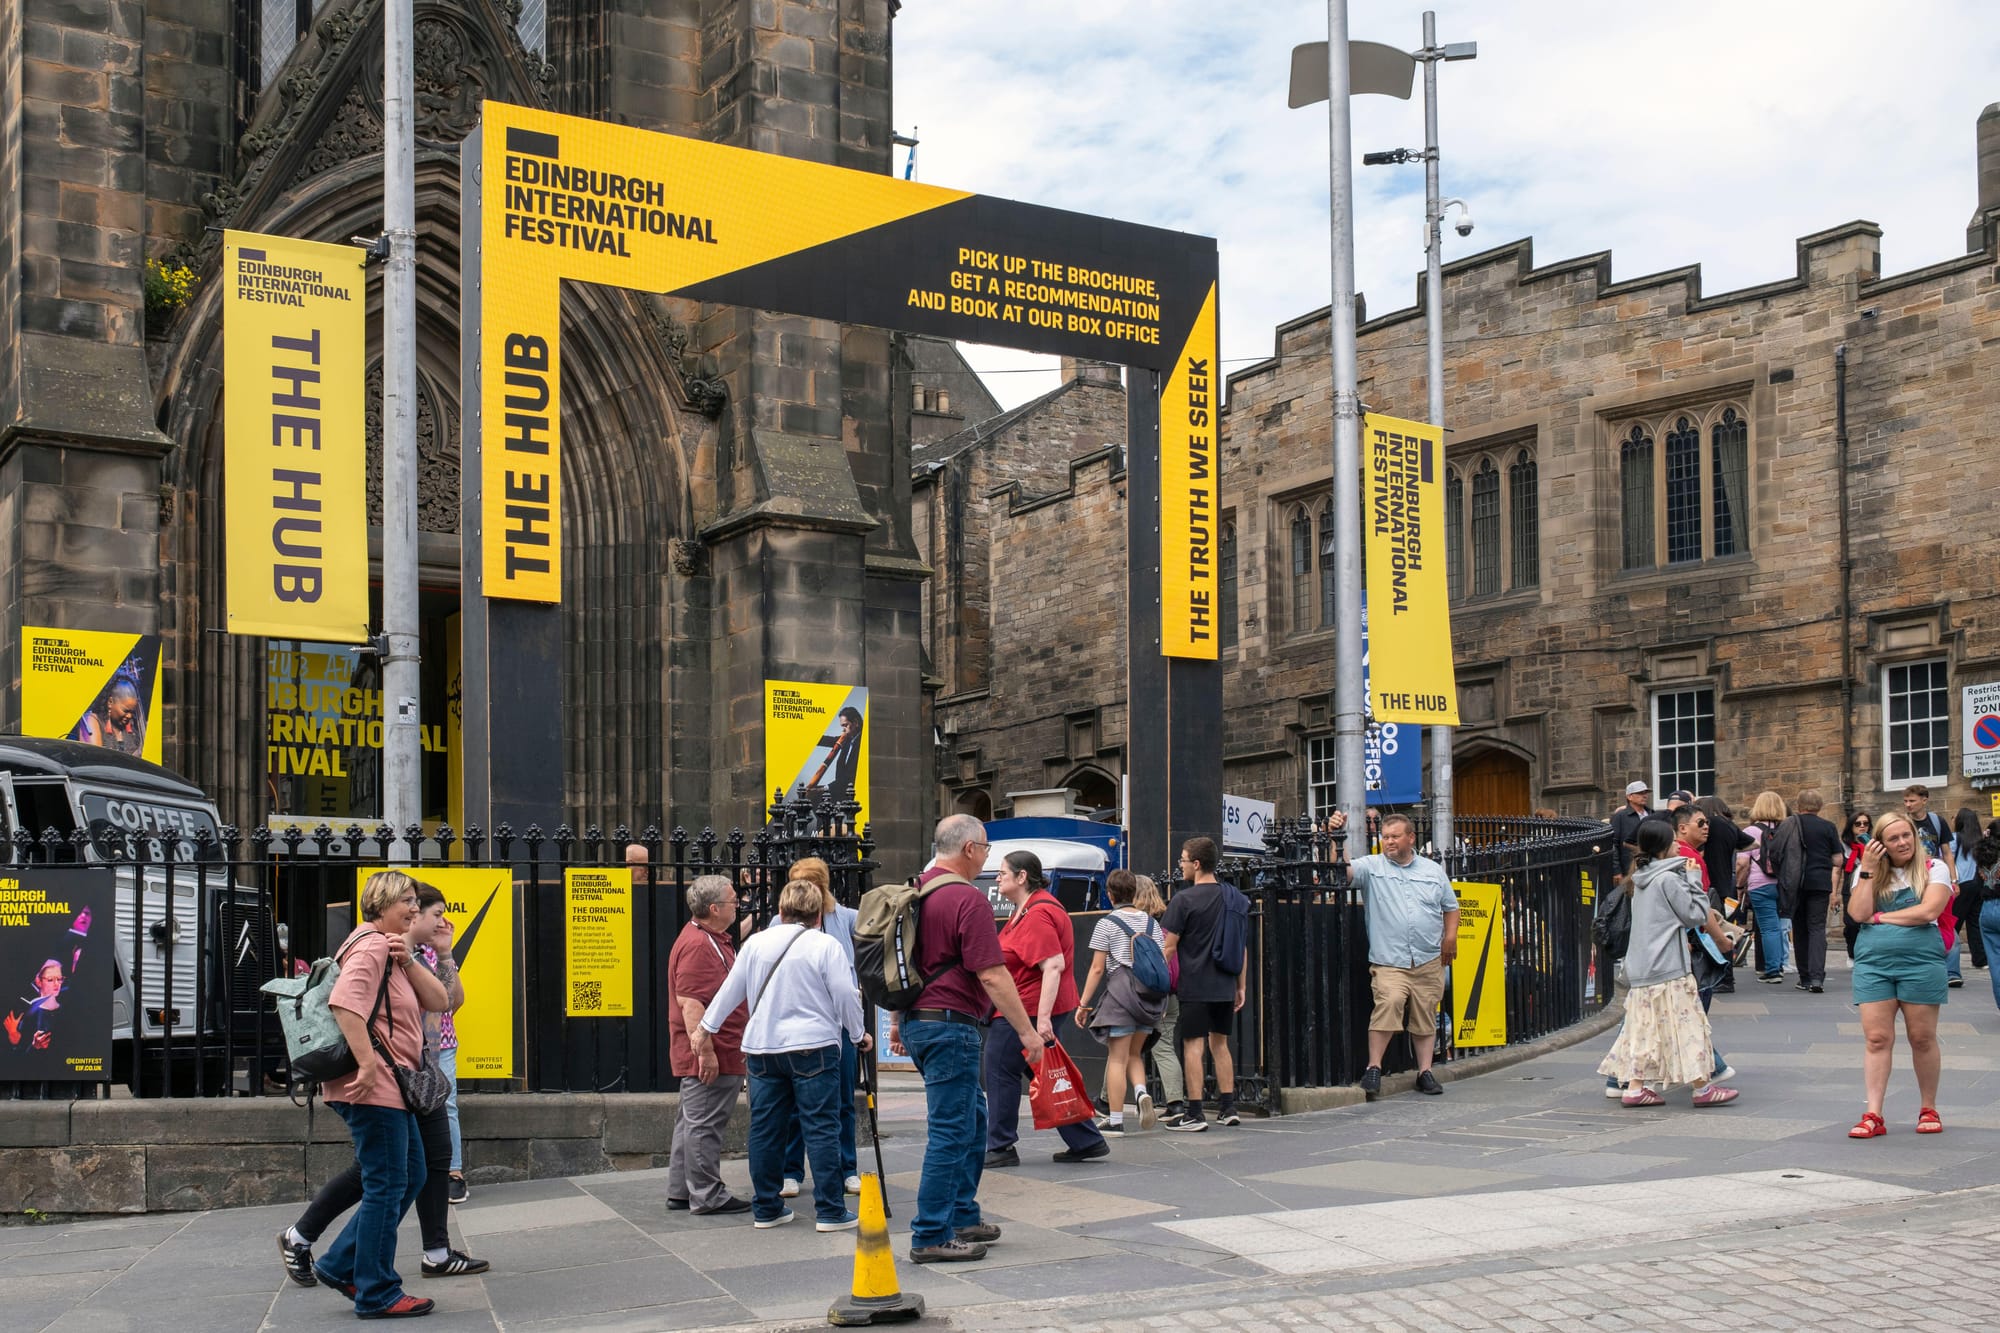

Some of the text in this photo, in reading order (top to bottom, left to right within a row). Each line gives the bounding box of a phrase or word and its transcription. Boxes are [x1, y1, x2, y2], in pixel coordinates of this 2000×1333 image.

[506, 155, 664, 207] EDINBURGH
[505, 184, 718, 245] INTERNATIONAL
[505, 213, 631, 258] FESTIVAL
[238, 261, 323, 283] EDINBURGH
[238, 274, 351, 301] INTERNATIONAL
[959, 247, 1160, 300] PICK UP THE BROCHURE,
[238, 287, 305, 307] FESTIVAL
[907, 289, 1160, 345] AND BOOK AT OUR BOX OFFICE
[950, 271, 1160, 322] GET A RECOMMENDATION
[271, 329, 323, 603] THE HUB
[504, 332, 550, 580] THE HUB
[1188, 356, 1210, 643] THE TRUTH WE SEEK
[1373, 430, 1389, 537] FESTIVAL
[1405, 435, 1422, 571] EDINBURGH
[1389, 432, 1408, 616] INTERNATIONAL
[32, 646, 86, 657] EDINBURGH
[32, 655, 104, 667] INTERNATIONAL
[32, 663, 75, 673] FESTIVAL
[773, 696, 812, 706] EDINBURGH
[773, 704, 826, 714] INTERNATIONAL
[773, 711, 804, 720] FESTIVAL
[1380, 693, 1411, 711] THE
[1415, 694, 1448, 712] HUB
[106, 800, 196, 837] COFFEE
